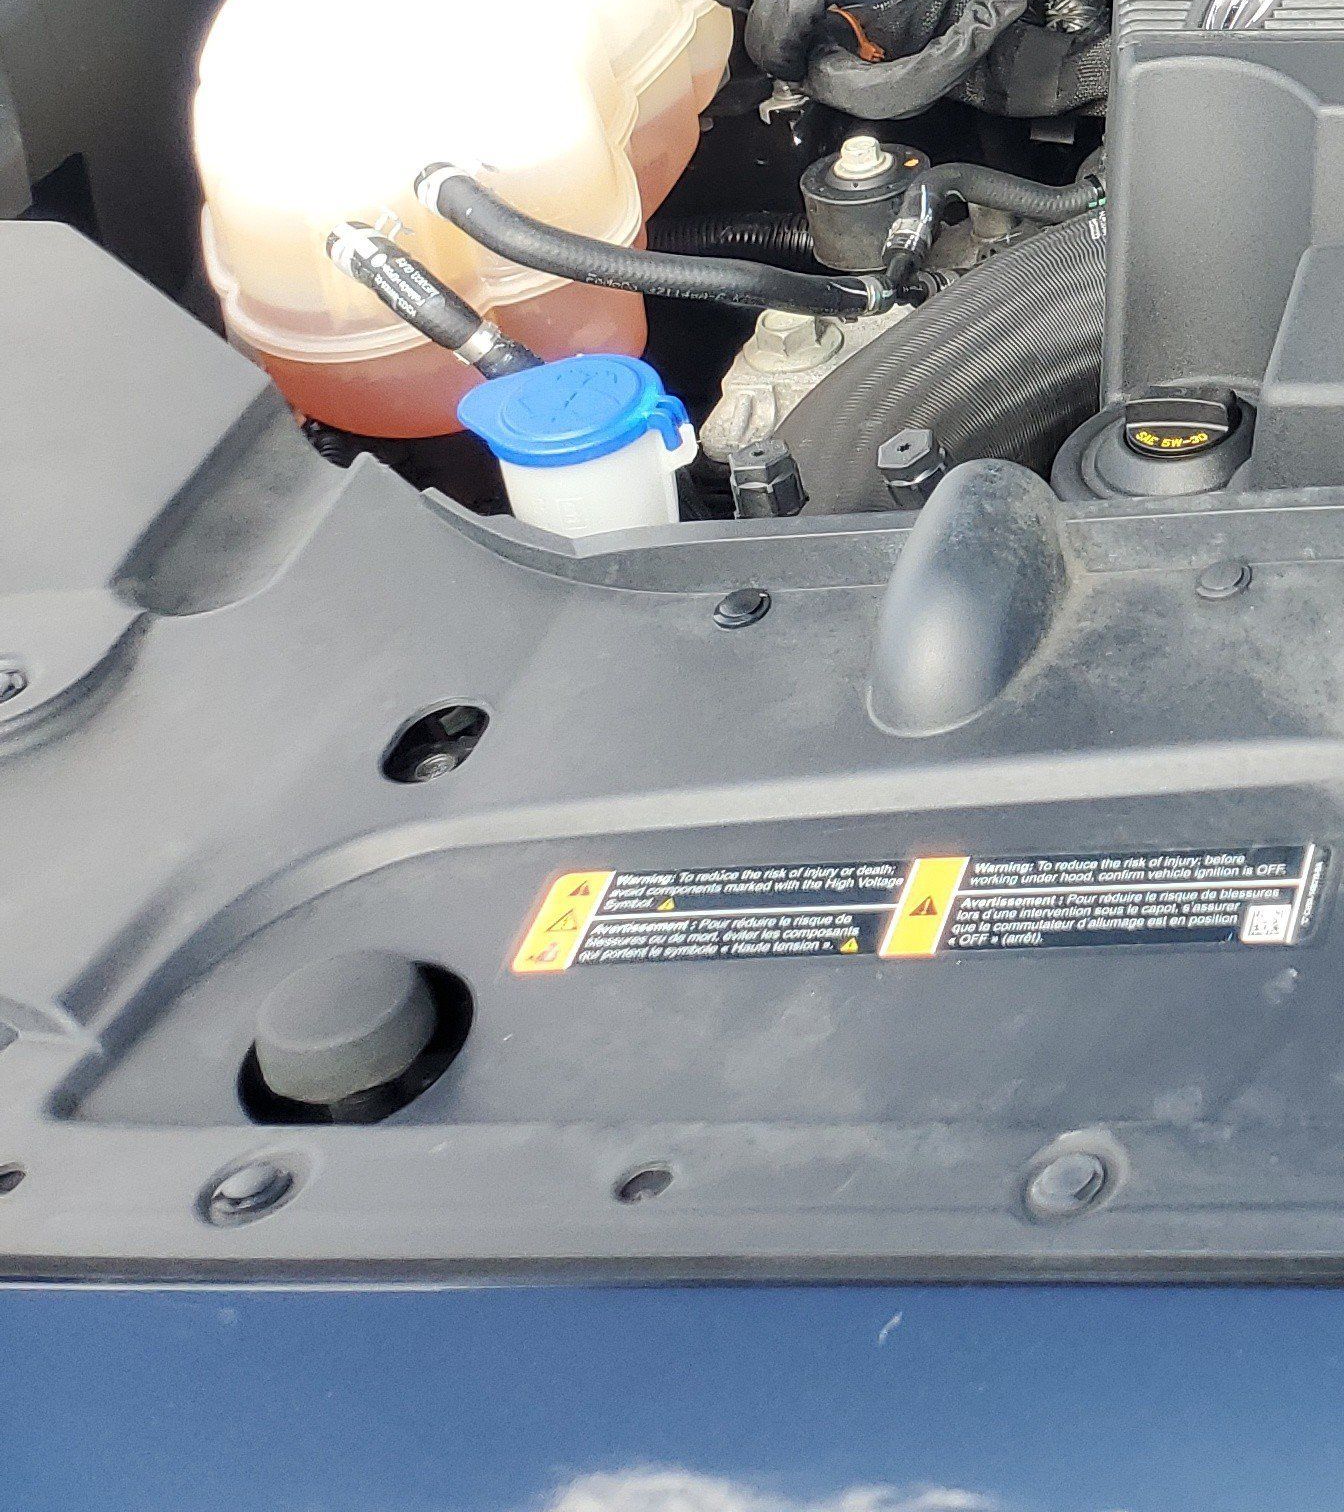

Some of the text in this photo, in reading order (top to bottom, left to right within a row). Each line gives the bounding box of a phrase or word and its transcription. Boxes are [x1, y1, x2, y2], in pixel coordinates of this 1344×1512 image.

[1136, 431, 1208, 447] SAE 5W-30
[975, 862, 1034, 874] Warning:
[1038, 861, 1052, 871] To
[1055, 860, 1097, 871] reduce
[1101, 859, 1121, 869] the
[1124, 857, 1145, 868] risk
[1149, 856, 1164, 867] of
[1205, 854, 1245, 865] before
[617, 874, 676, 886] Warning:
[679, 872, 694, 883] To
[695, 870, 739, 882] reduce
[741, 870, 762, 880] the
[763, 868, 786, 879] risk
[789, 867, 804, 878] of
[805, 867, 839, 879] injury
[840, 867, 855, 876] or
[970, 863, 1286, 886] working under hood, confirm vehicle ignition is OFF.
[646, 883, 722, 896] components
[724, 879, 772, 894] marked
[775, 880, 799, 890] with
[802, 878, 823, 889] the
[825, 878, 854, 890] High
[859, 877, 904, 889] Voltage
[961, 896, 1056, 908] Avertissement
[1067, 893, 1096, 904] Pour
[1145, 892, 1157, 901] le
[1159, 890, 1198, 902] risque
[1200, 889, 1217, 899] de
[1219, 888, 1279, 899] blessures
[956, 911, 979, 920] lors
[982, 909, 1017, 919] d'une
[1019, 906, 1091, 919] intervention
[1095, 905, 1124, 916] sous
[1127, 904, 1138, 914] le
[1182, 901, 1240, 913] s'assurer
[699, 918, 731, 930] Pour
[793, 915, 832, 926] risque
[835, 913, 852, 923] de
[952, 914, 1238, 934] que le commutateur d'allumage est en position
[783, 927, 859, 939] composants
[959, 933, 989, 945] OFF
